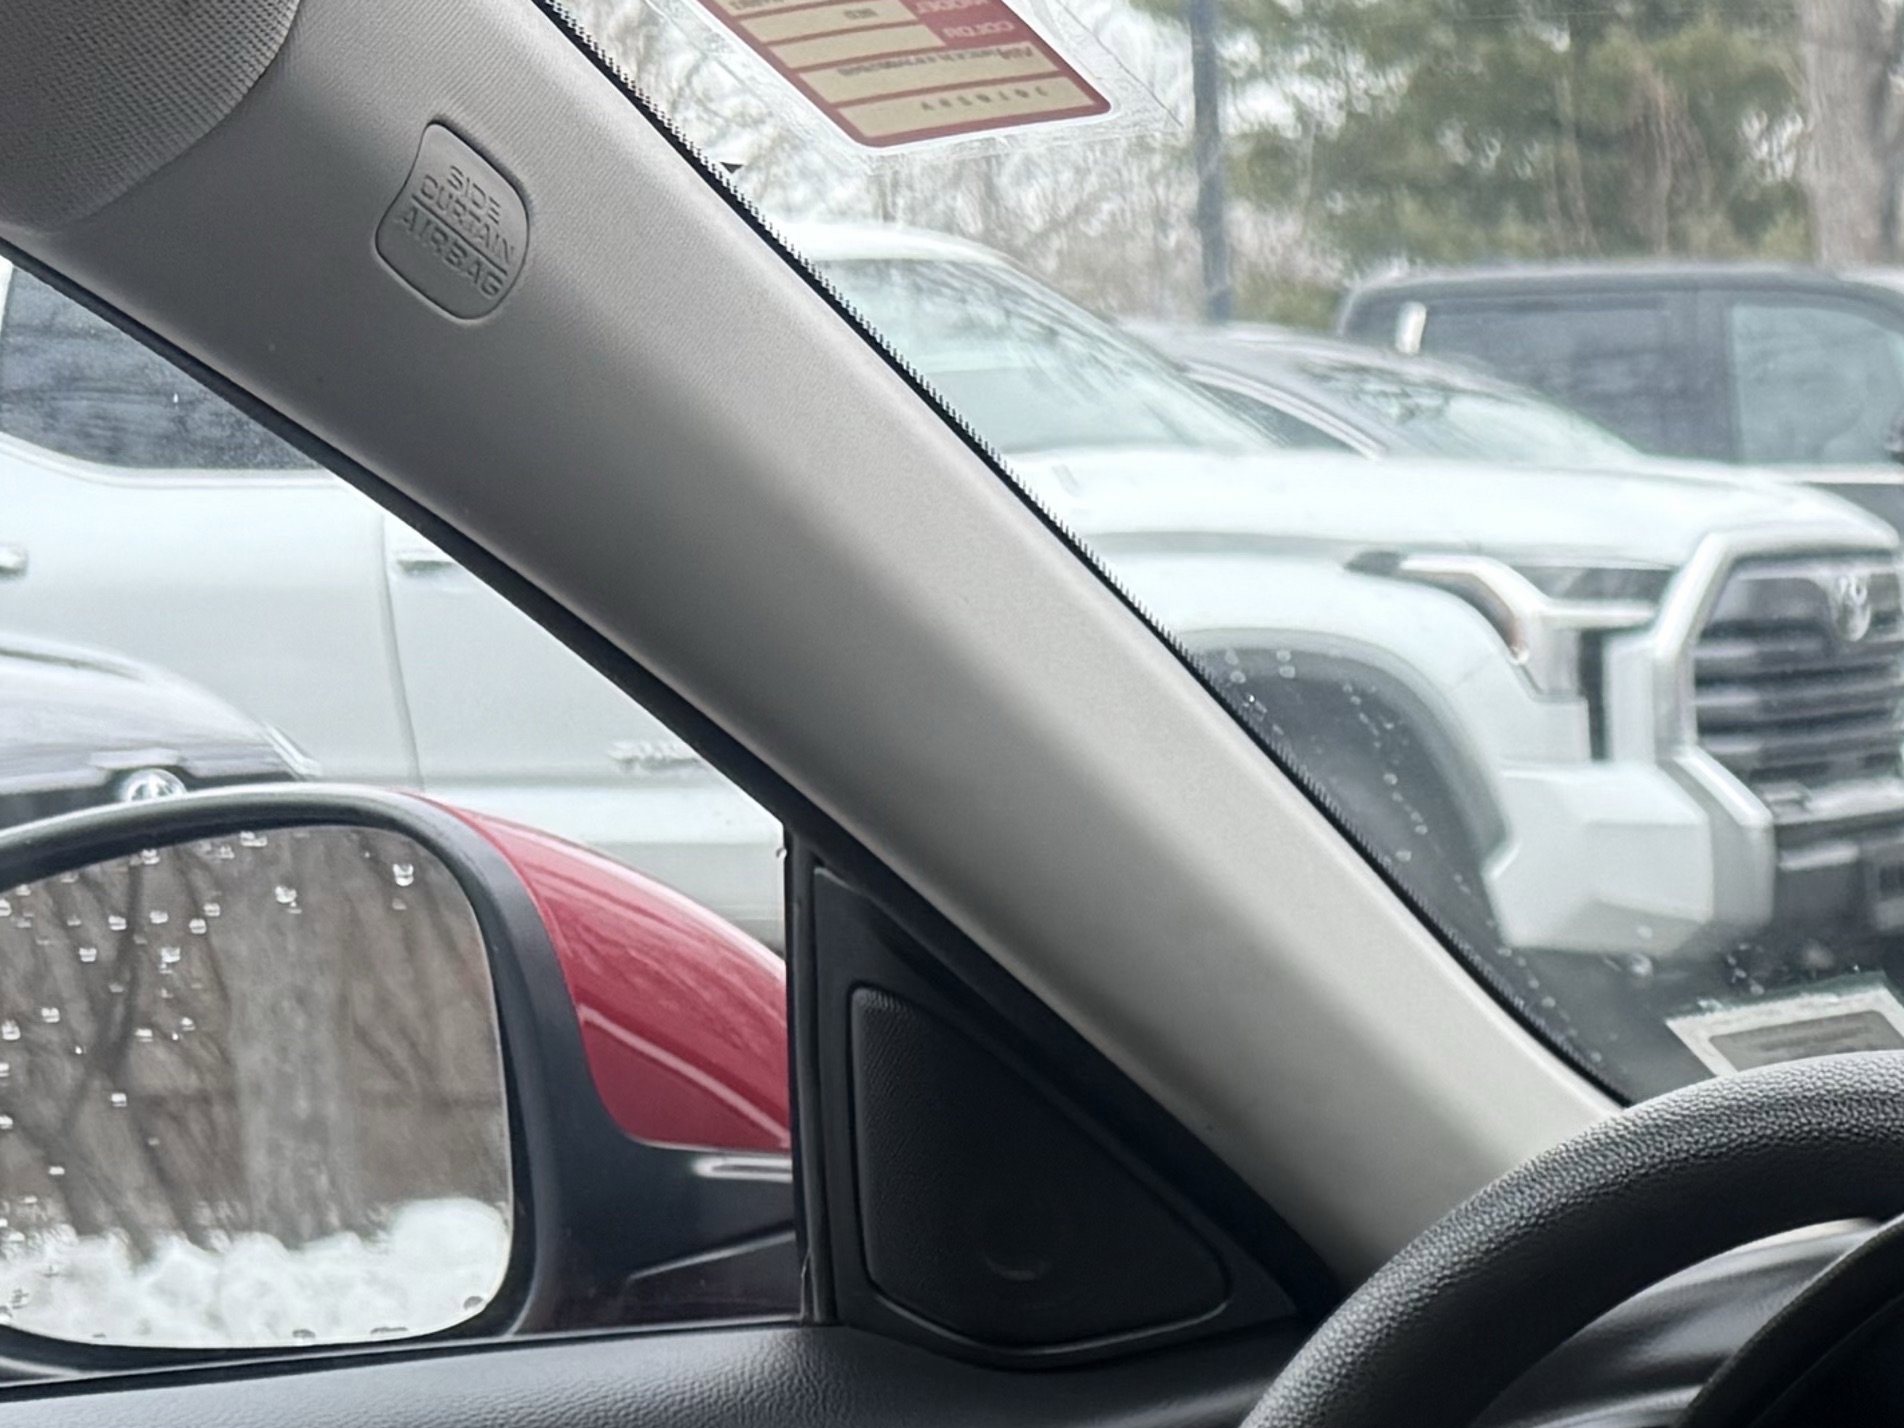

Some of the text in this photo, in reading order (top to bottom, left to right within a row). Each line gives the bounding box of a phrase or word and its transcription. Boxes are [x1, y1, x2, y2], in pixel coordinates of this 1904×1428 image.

[420, 174, 514, 265] CURTAIN
[447, 165, 501, 225] SIDE
[403, 204, 504, 298] AIRBAG
